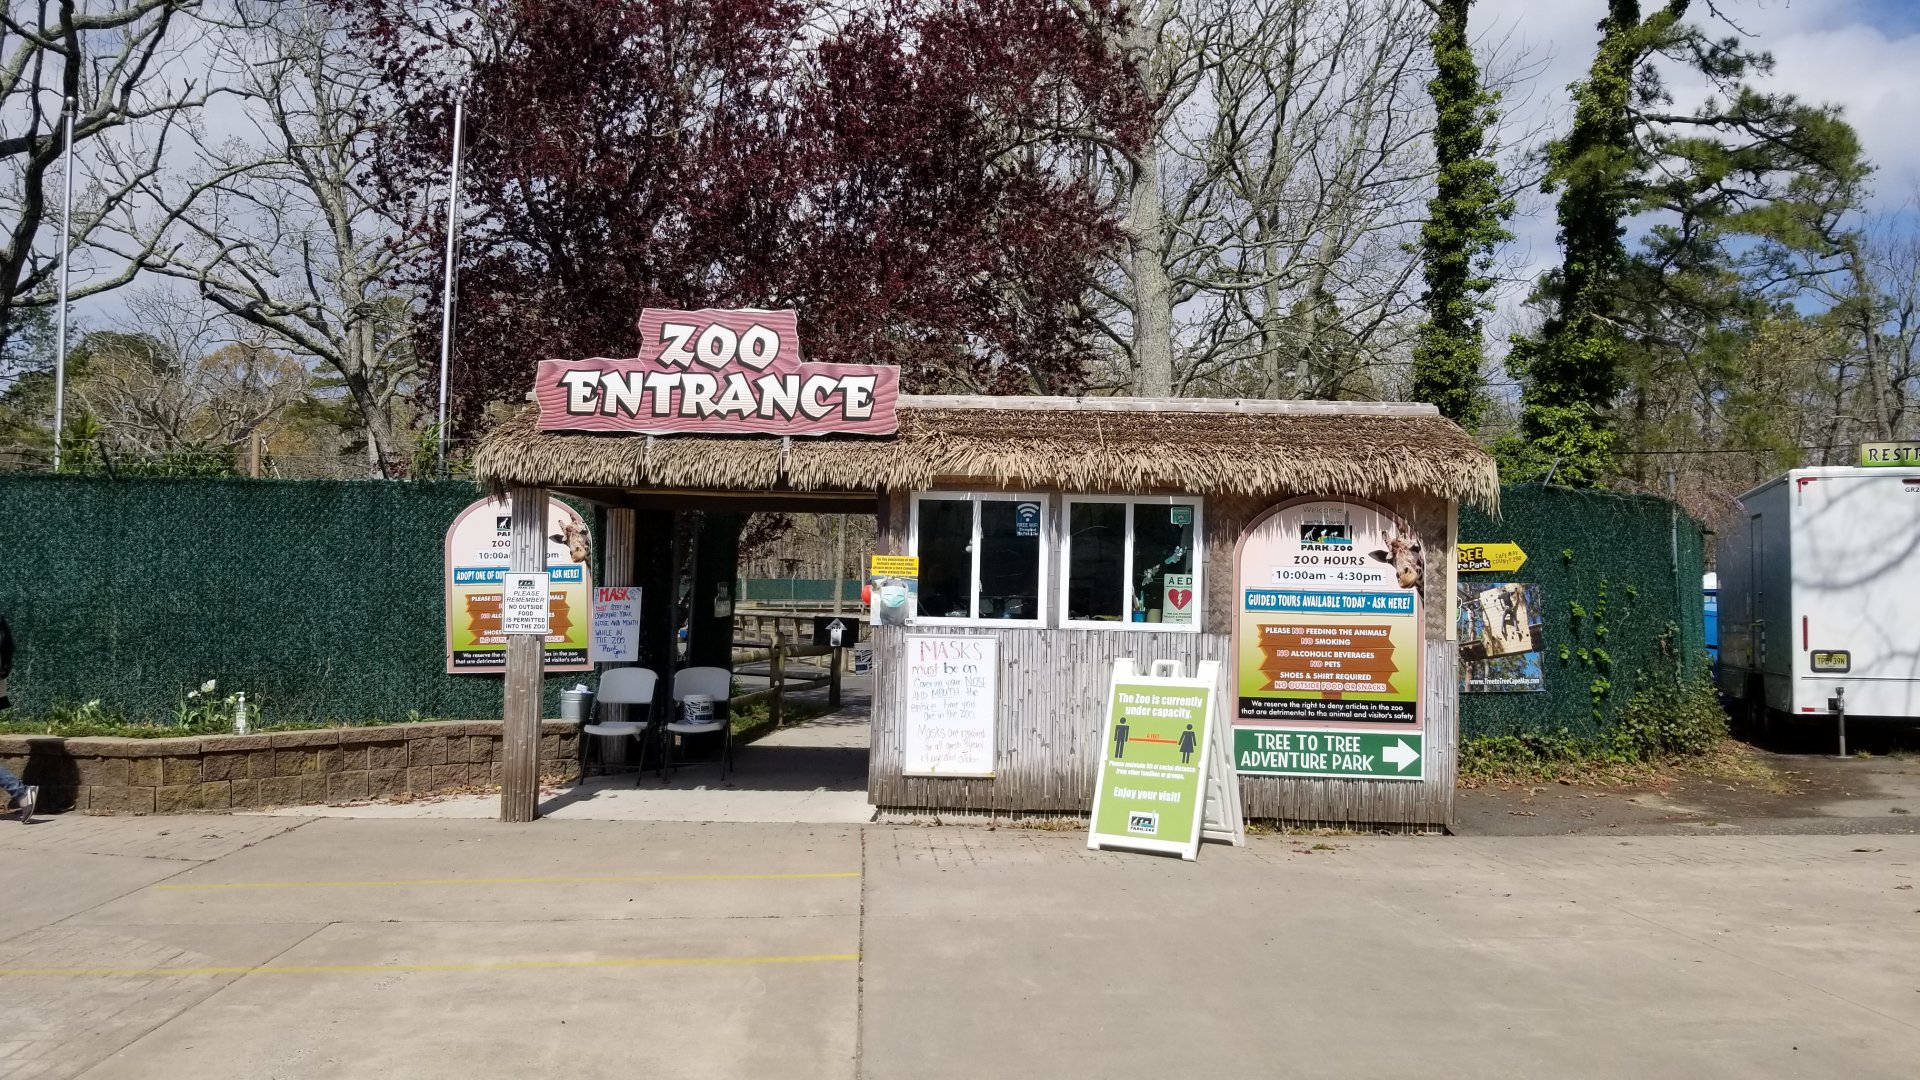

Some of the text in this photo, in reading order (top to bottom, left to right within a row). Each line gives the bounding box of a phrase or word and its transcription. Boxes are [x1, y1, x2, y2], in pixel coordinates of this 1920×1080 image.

[655, 322, 781, 372] ZOO
[557, 369, 878, 422] ENTRANCE
[1303, 506, 1343, 514] Welcome
[1294, 555, 1365, 566] ZOO HOURS
[1457, 547, 1483, 563] REE
[1469, 559, 1490, 568] Park
[456, 568, 580, 580] ADOPT ONE OF ASK HERE!
[1276, 570, 1382, 583] 10:00am 4:30pm
[1168, 576, 1192, 586] AED
[599, 588, 630, 602] MASK
[1248, 594, 1410, 610] GUIDED TOURS AVAILABLE TODAY ASK HERE!
[1266, 626, 1290, 634] PLEASE
[1292, 627, 1305, 635] NO
[1354, 629, 1387, 637] ANIMALS
[1300, 637, 1314, 645] NO
[920, 640, 982, 662] MASKS
[1276, 650, 1290, 658] NO
[1291, 650, 1332, 658] ALCOHOLIC
[912, 662, 977, 676] must be on
[1310, 660, 1324, 668] NO
[1335, 673, 1372, 681] REQUIRED
[1274, 680, 1386, 692] NO OUTSIDE FOOD OR SNACKS
[1118, 692, 1202, 708] The Zoo is currently
[1302, 702, 1318, 710] right
[1327, 702, 1344, 711] deny
[1125, 706, 1192, 720] under capacity.
[1268, 708, 1306, 716] detrimental
[1394, 712, 1414, 720] safety
[1254, 732, 1360, 752] TREE TO TREE
[1240, 750, 1374, 772] ADVENTURE PARK
[1113, 786, 1181, 802] Enjoy your visit!
